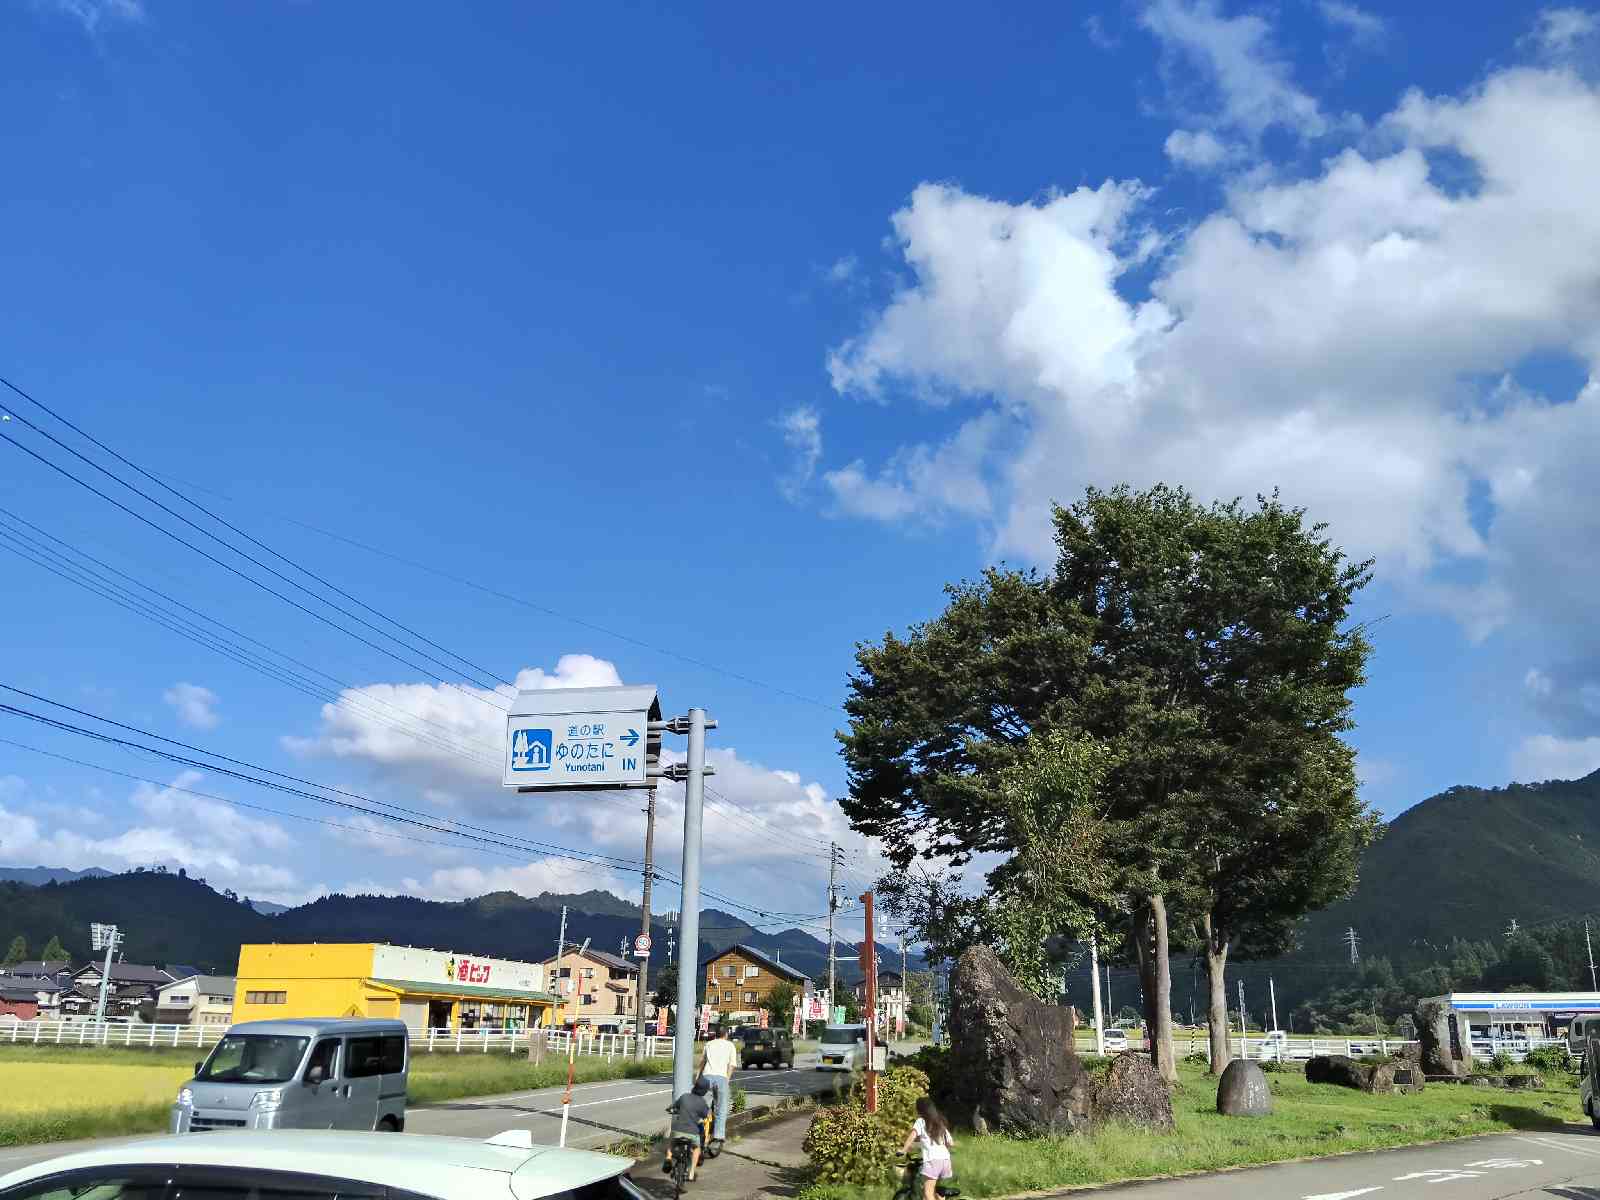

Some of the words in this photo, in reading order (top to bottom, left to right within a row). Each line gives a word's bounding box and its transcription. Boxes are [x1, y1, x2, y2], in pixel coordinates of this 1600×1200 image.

[567, 723, 606, 737] 道の駅
[556, 742, 614, 760] ゆのたに
[565, 762, 605, 772] Yunotani
[622, 758, 636, 771] IN
